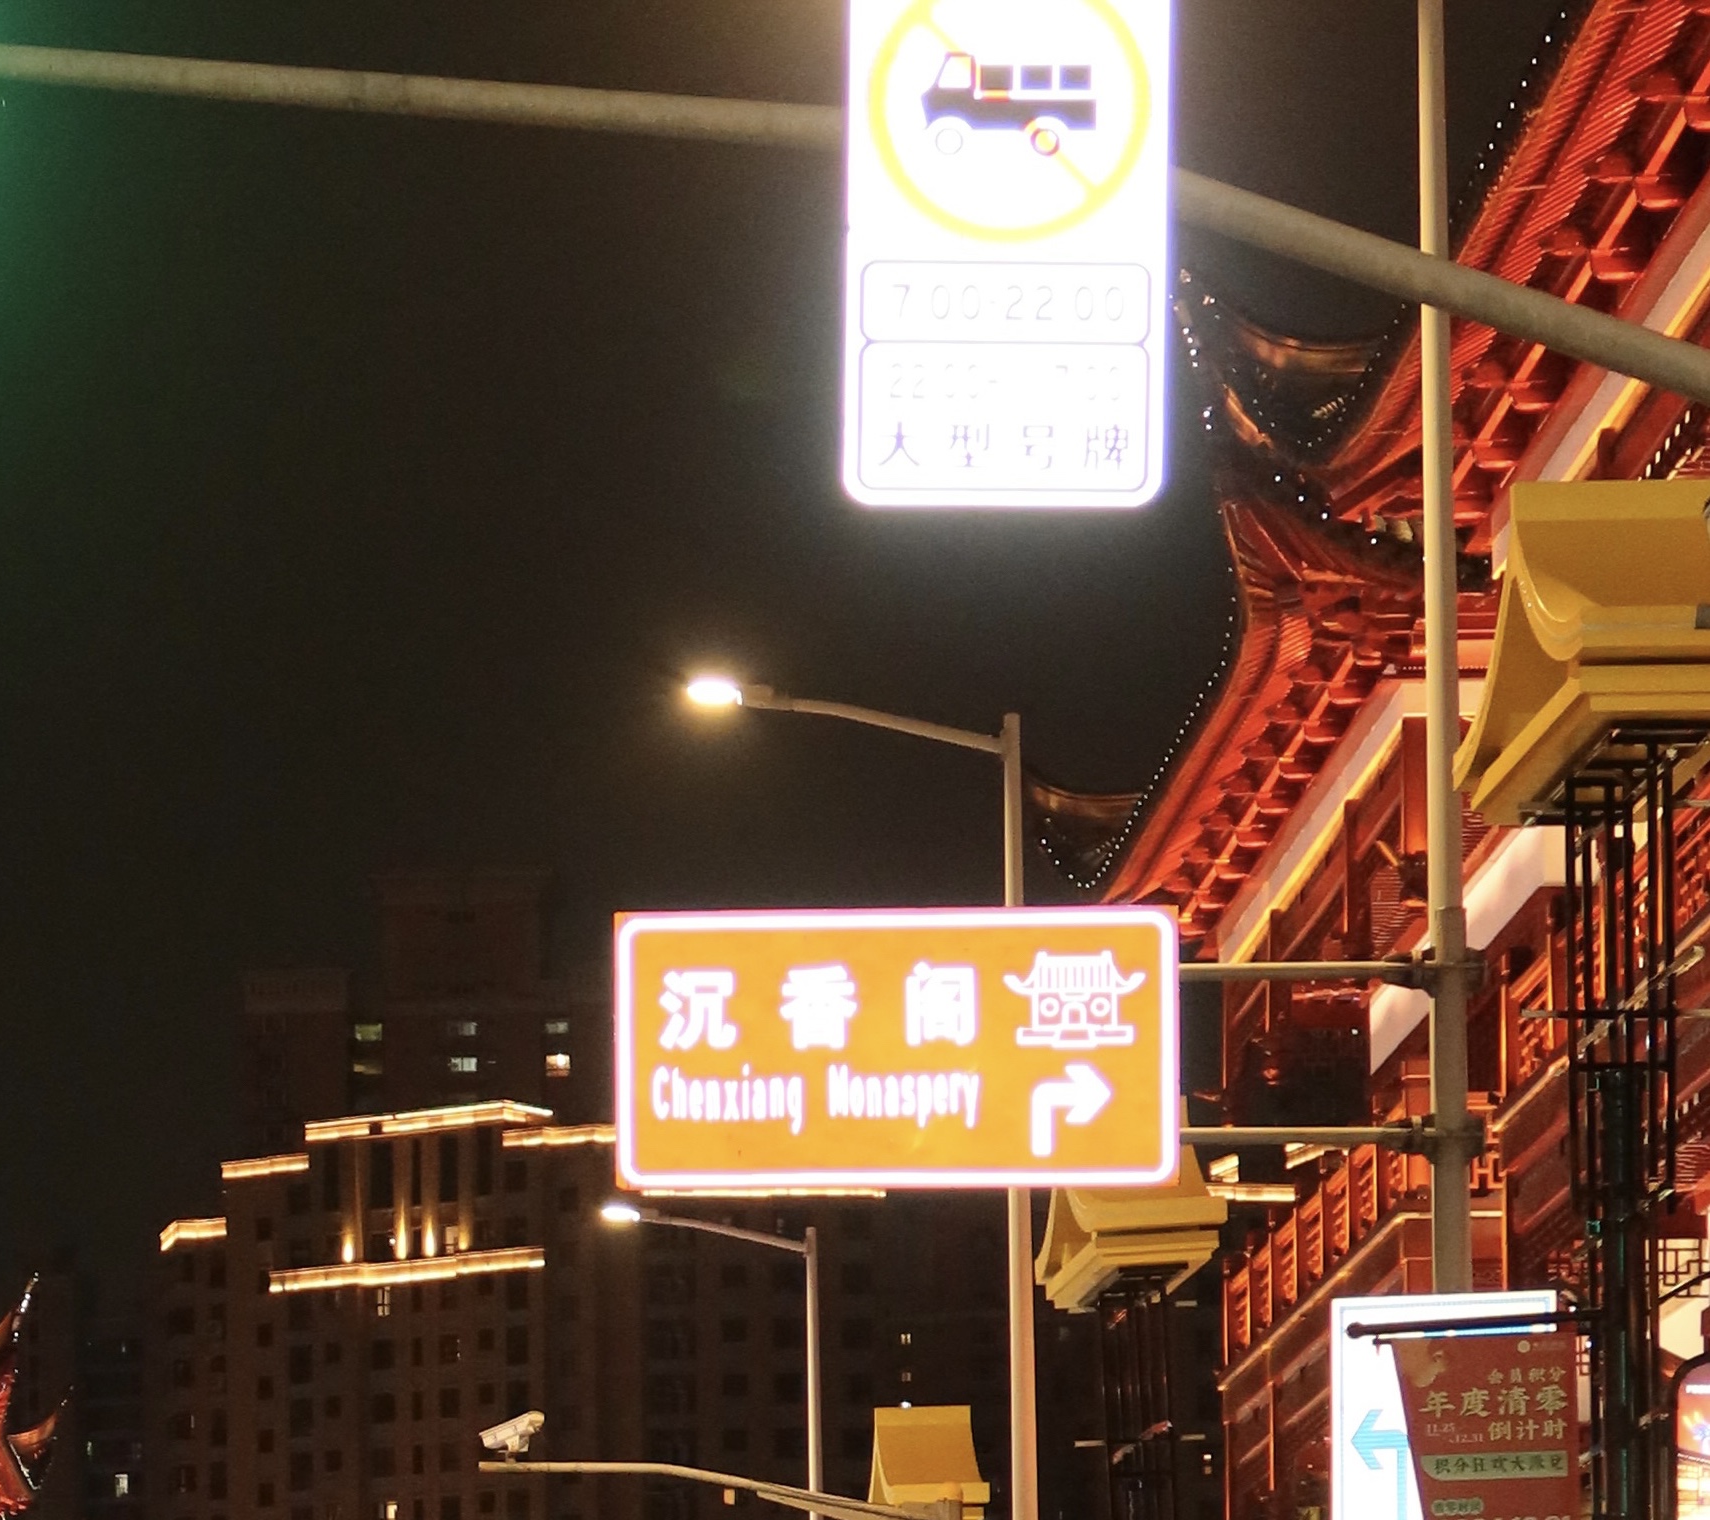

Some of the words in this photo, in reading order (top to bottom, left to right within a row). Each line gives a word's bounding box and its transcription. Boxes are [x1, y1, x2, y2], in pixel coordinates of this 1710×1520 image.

[878, 421, 1129, 471] 大型号牌
[658, 961, 979, 1050] 沉香阁
[651, 1063, 804, 1135] Chenxiang
[1418, 1384, 1568, 1418] 年度清零
[1487, 1418, 1568, 1441] 倒计时
